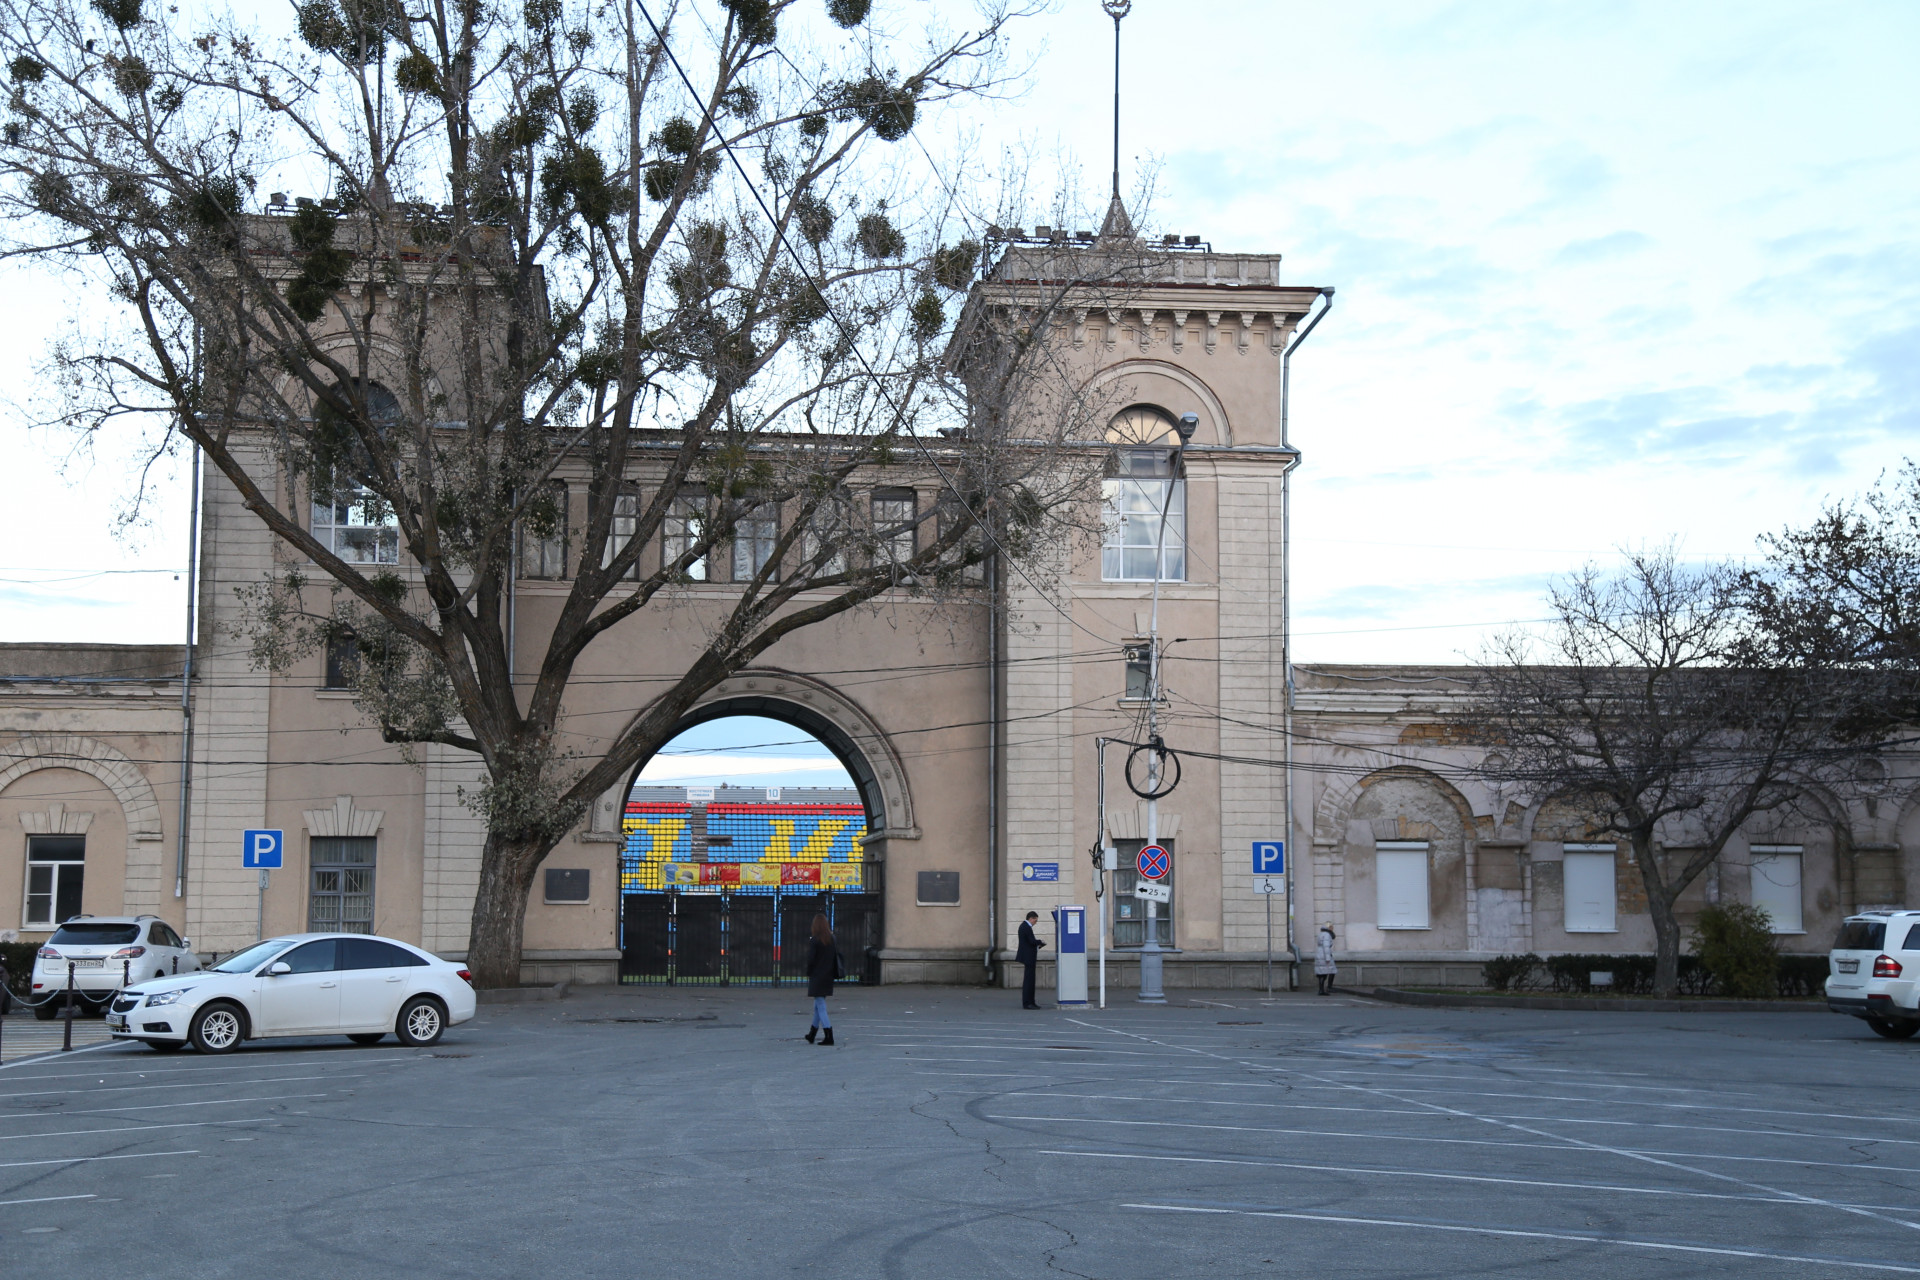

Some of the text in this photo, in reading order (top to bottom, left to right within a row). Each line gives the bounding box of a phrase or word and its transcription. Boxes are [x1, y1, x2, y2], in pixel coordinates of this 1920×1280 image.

[768, 789, 779, 798] 10
[254, 834, 276, 864] P
[1261, 845, 1279, 871] P
[1148, 888, 1159, 896] 25
